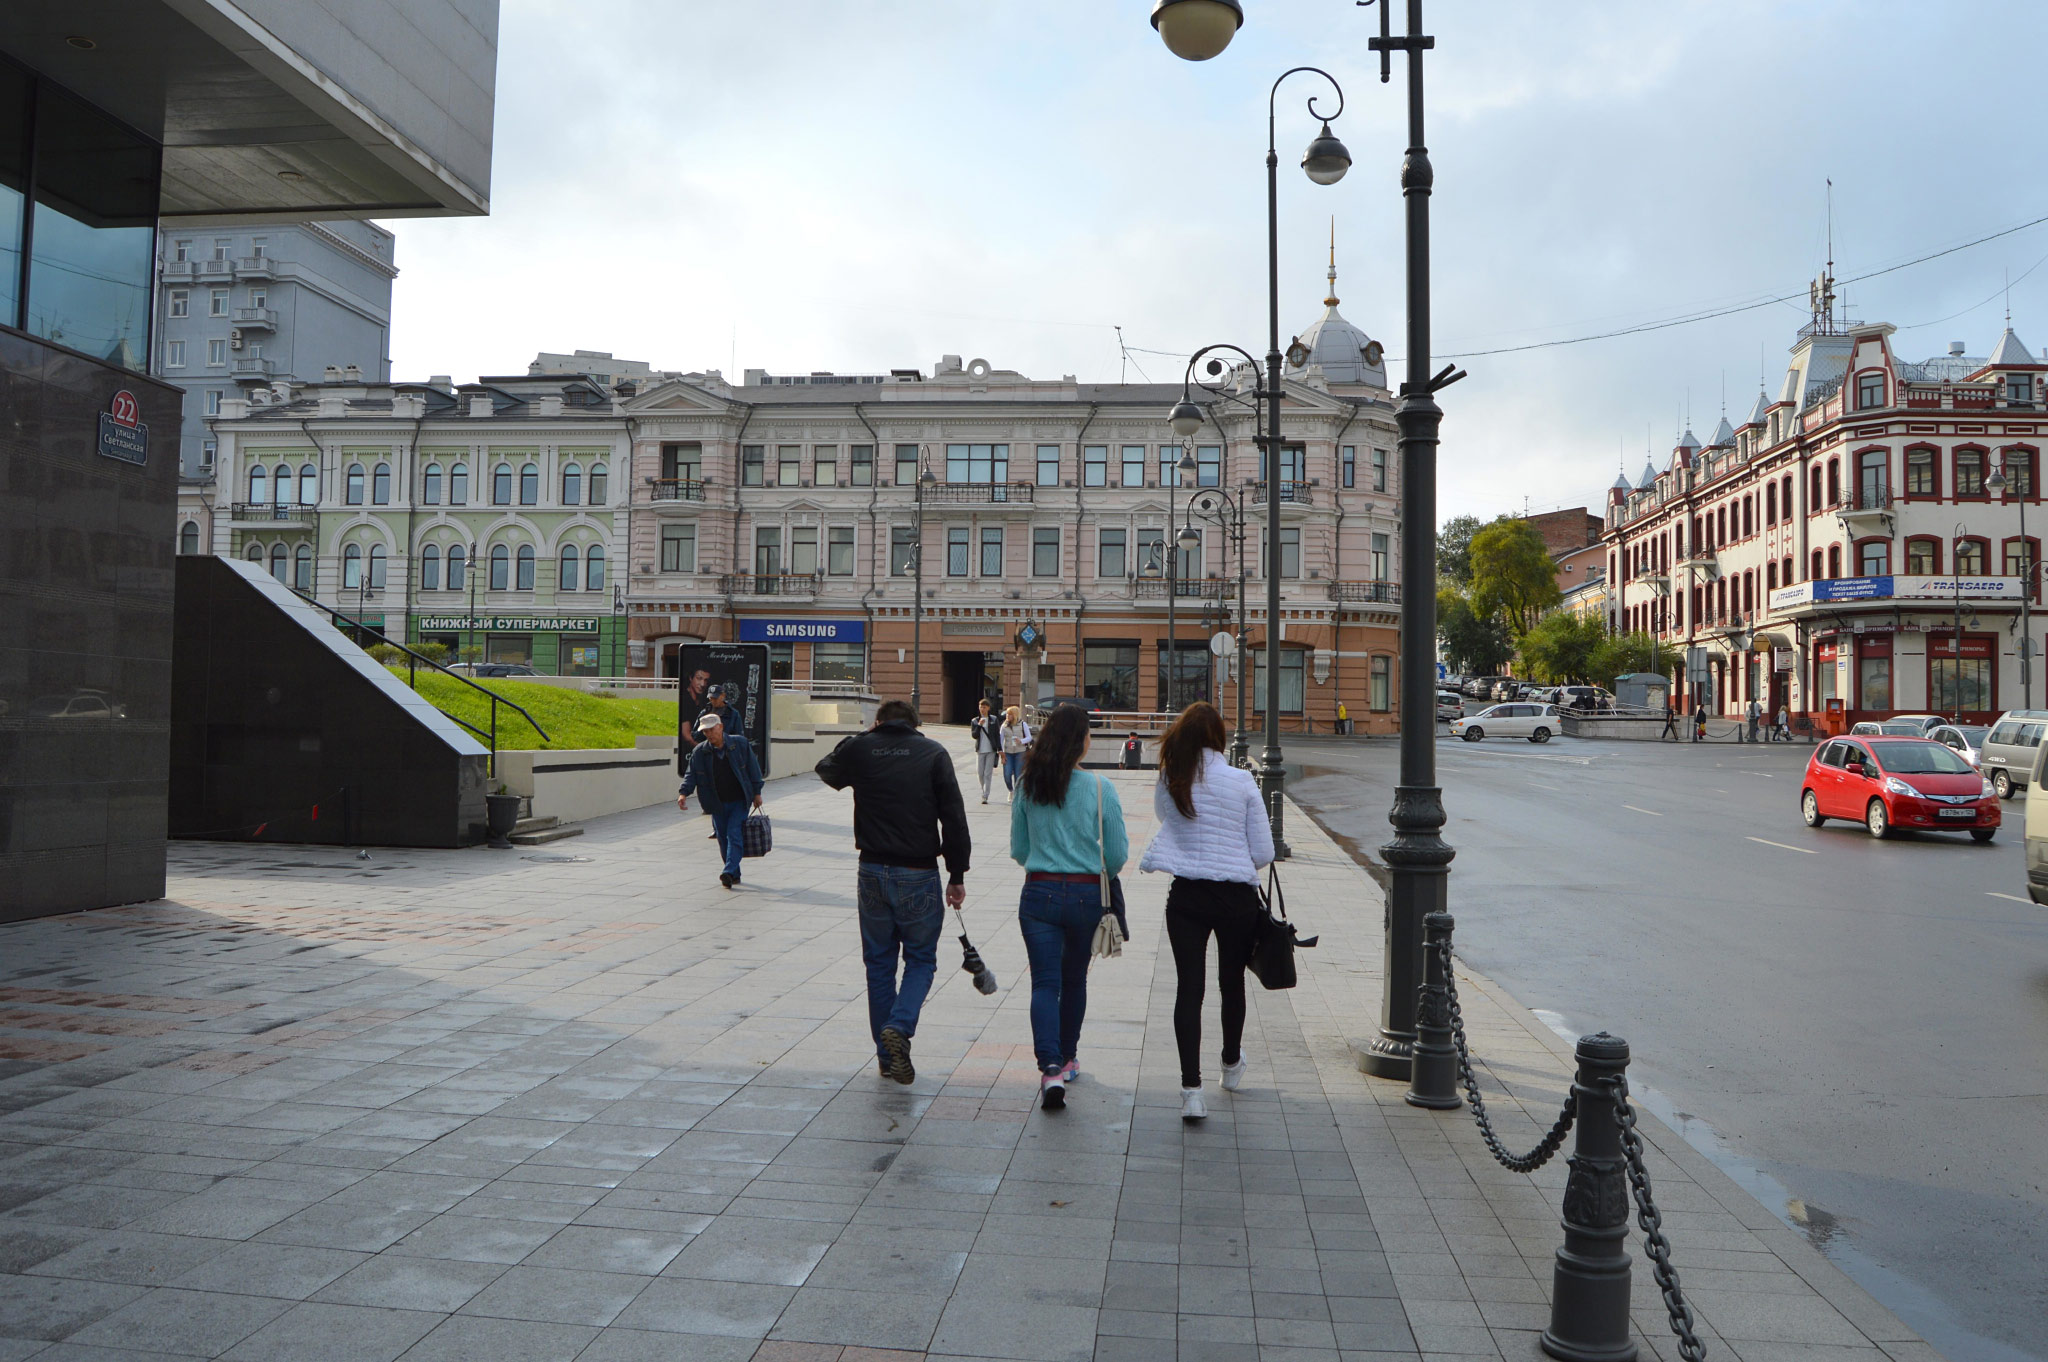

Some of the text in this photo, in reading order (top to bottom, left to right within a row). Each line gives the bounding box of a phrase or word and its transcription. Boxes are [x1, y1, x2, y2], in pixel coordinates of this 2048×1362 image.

[117, 397, 134, 422] 22
[114, 428, 136, 440] улица
[104, 433, 144, 453] Светланская
[1933, 582, 2004, 590] TRANSAERO
[421, 617, 595, 630] КНИЖНЫЙ СУПЕРМАРКЕТ
[766, 624, 836, 637] SAMSUNG
[871, 746, 910, 756] adidas
